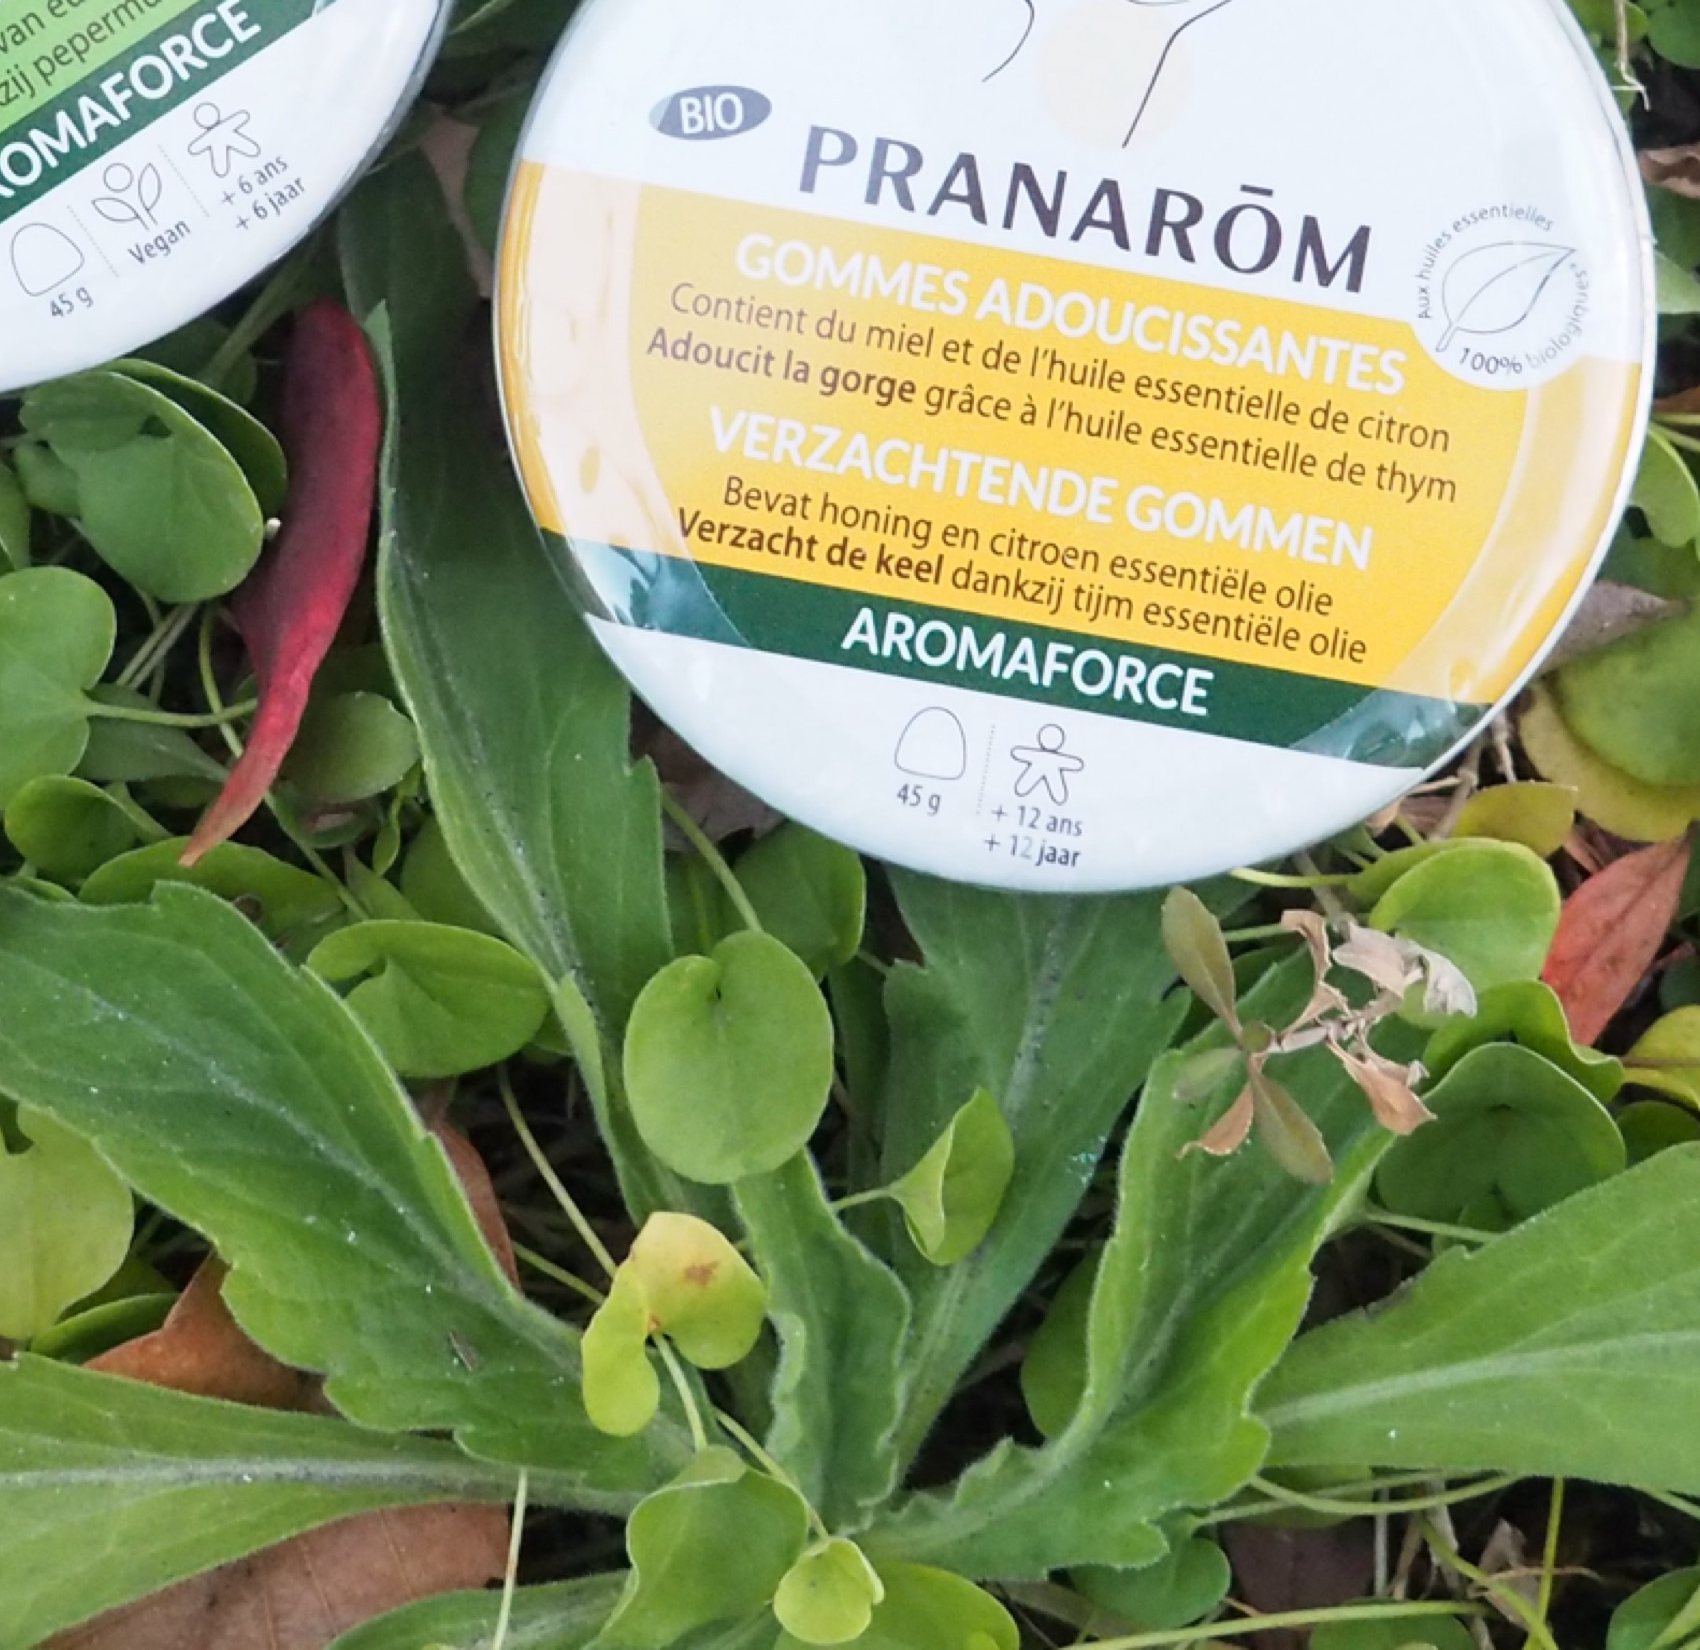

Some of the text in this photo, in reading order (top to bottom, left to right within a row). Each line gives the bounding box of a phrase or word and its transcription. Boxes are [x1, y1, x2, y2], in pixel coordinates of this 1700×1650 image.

[680, 93, 743, 135] BIO
[221, 156, 290, 205] + 6 ans
[235, 178, 306, 231] + 6 jaar
[799, 124, 1371, 293] PRANARŌM
[128, 219, 191, 265] Vegan
[1414, 203, 1554, 320] Aux huiles essentielles
[48, 286, 95, 319] 45 g
[735, 233, 1409, 396] GOMMES ADOUCISSANTES
[670, 282, 1450, 453] Contient du miel et de l'huile essentielle de citron
[1458, 347, 1523, 375] 100%
[647, 325, 1457, 504] Adoucit la gorge grâce à l'huile essentielle de thym
[710, 406, 1373, 571] VERZACHTENDE GOMMEN
[678, 507, 1367, 664] Verzacht de keel dankzij tijm essentiële olie
[723, 475, 1334, 616] Bevat honing en citroen essentiële olie
[841, 607, 1214, 716] AROMAFORCE
[896, 783, 941, 817] 45 g
[991, 805, 1083, 837] + 12 ans
[984, 834, 1081, 867] + 12 jaar
